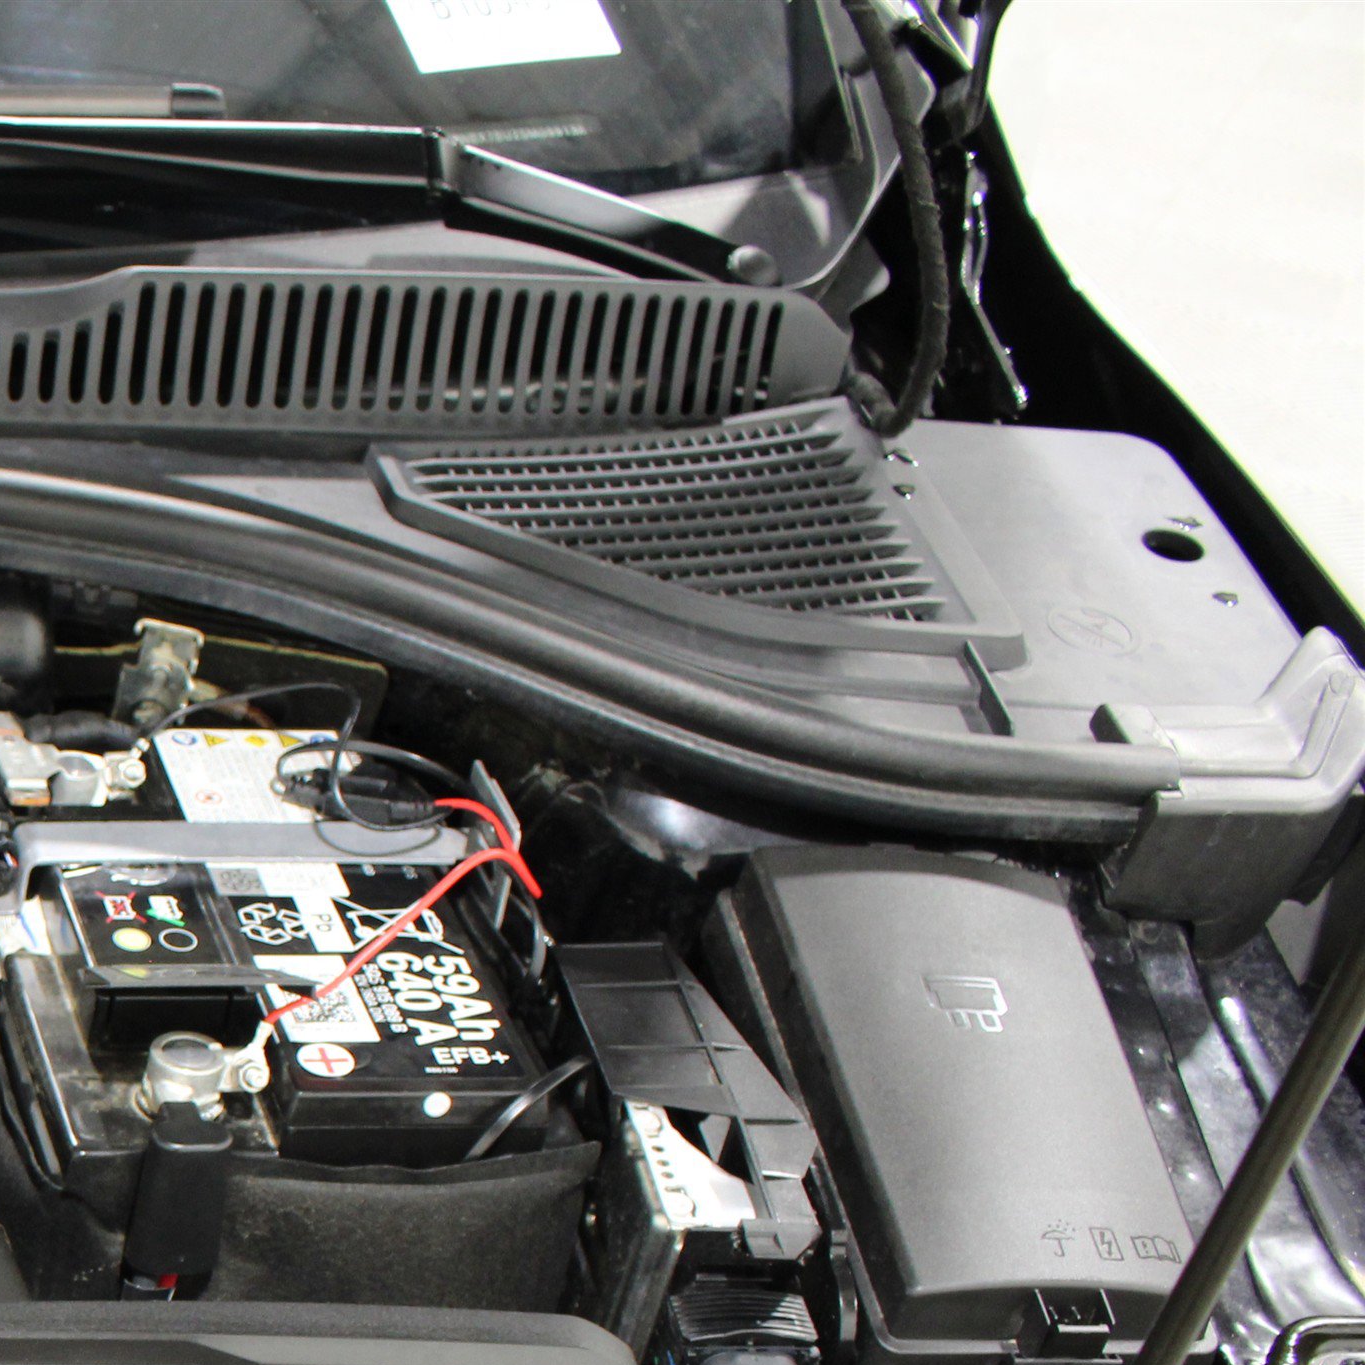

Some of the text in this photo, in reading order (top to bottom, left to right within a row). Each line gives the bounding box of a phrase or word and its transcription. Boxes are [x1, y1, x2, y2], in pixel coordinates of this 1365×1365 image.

[376, 951, 444, 1012] 640
[422, 954, 502, 1042] 59Ah
[405, 1017, 459, 1046] A
[431, 1046, 510, 1065] EFB+
